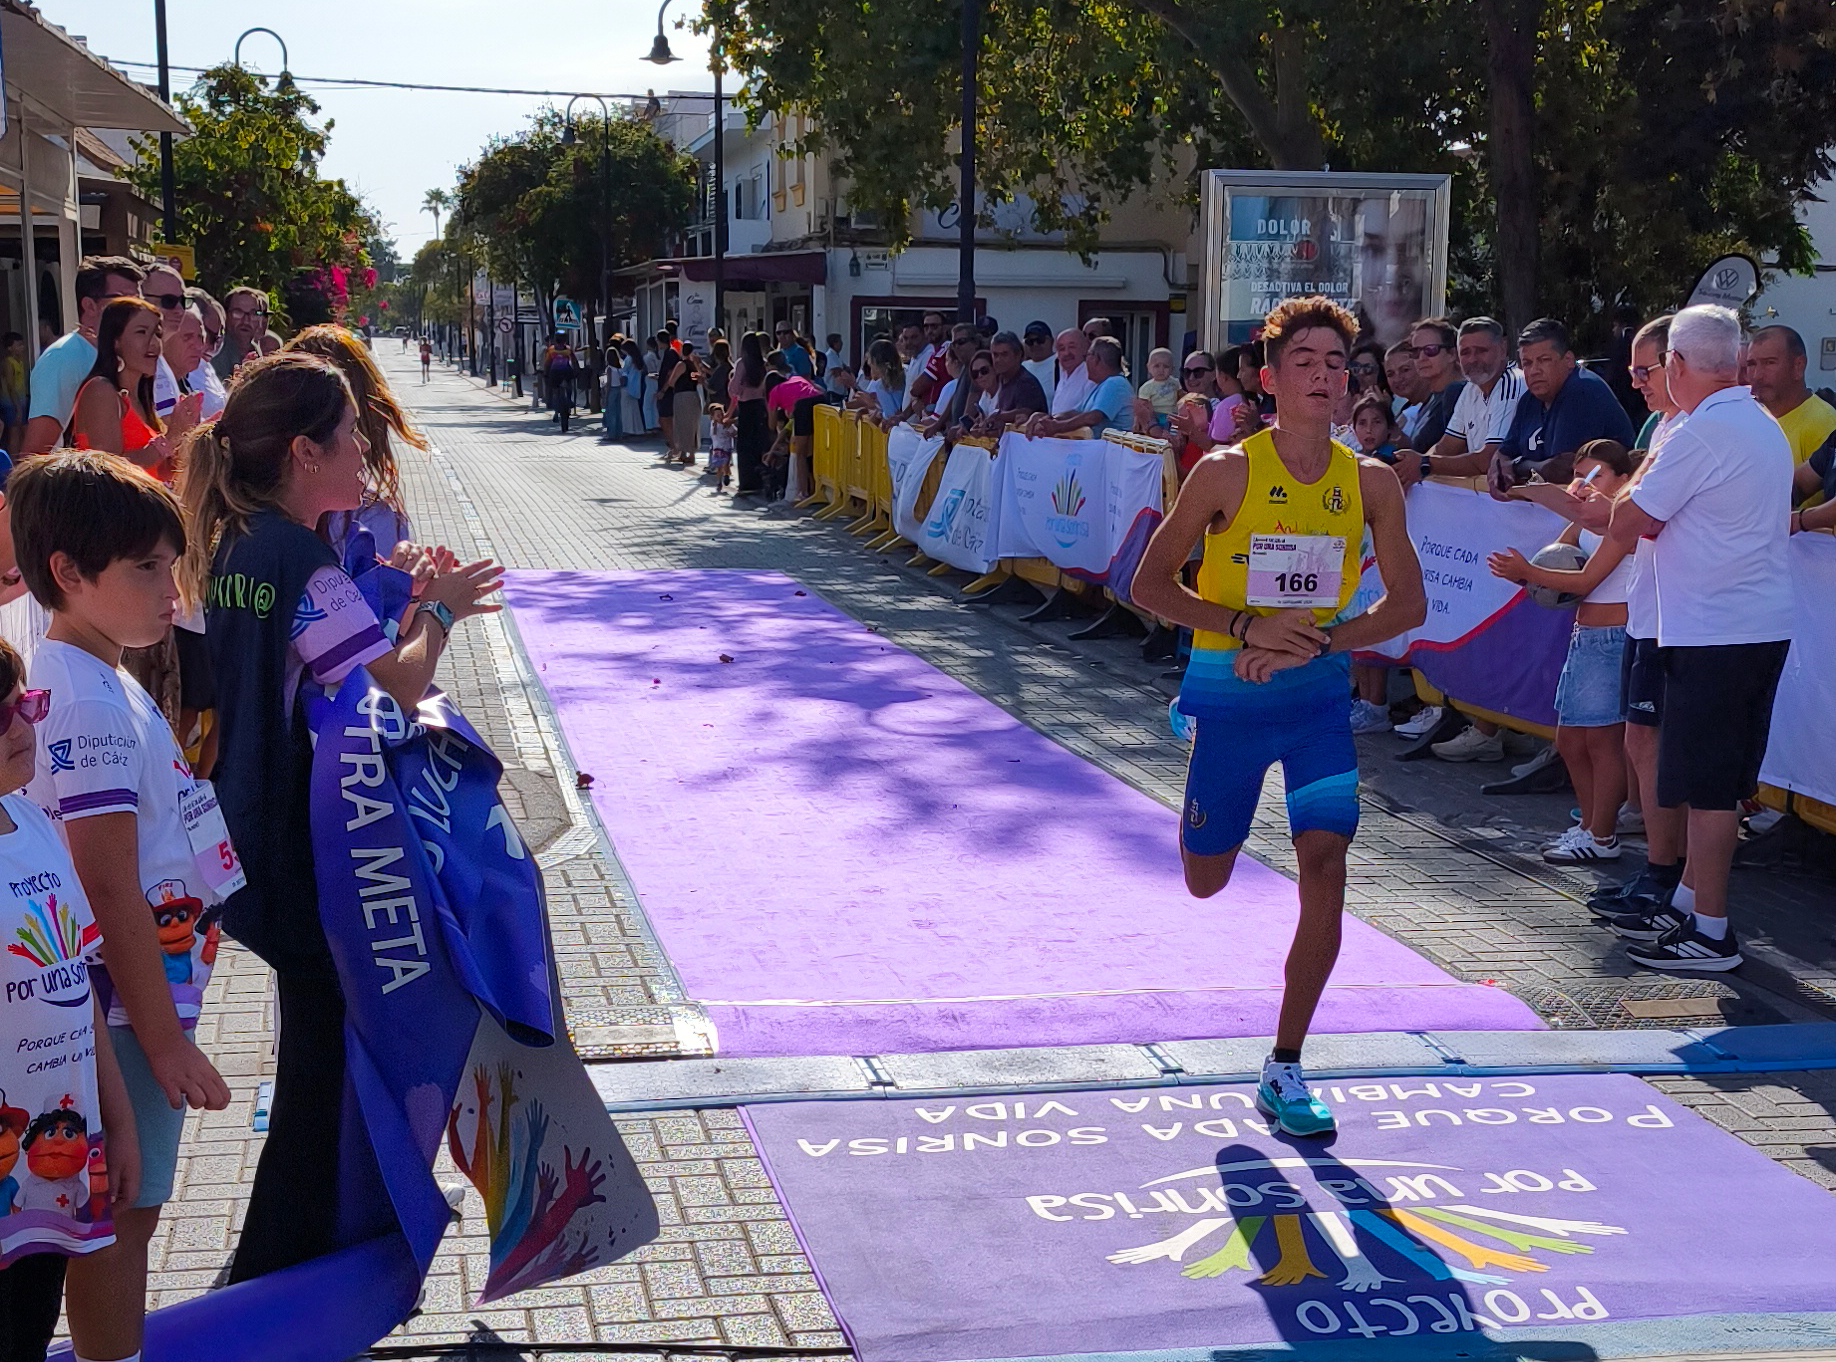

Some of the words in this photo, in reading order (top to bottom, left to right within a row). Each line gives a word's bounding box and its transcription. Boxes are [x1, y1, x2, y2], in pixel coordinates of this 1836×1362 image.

[1257, 218, 1312, 236] DOLOR
[1251, 281, 1303, 292] DESACTIVA
[1304, 282, 1316, 293] EL
[1318, 282, 1349, 293] DOLOR
[1421, 535, 1453, 559] PORQUE
[1453, 548, 1479, 566] CADA
[1275, 573, 1318, 592] 166
[1441, 573, 1473, 592] CAMBIA
[330, 597, 347, 611] de
[80, 754, 98, 768] de
[351, 846, 432, 995] META
[17, 1032, 67, 1053] PORQUE
[26, 1056, 68, 1075] CAMBIA
[1109, 1092, 1255, 1113] UNA
[1312, 1082, 1537, 1103] CAMBI
[914, 1100, 1079, 1124] VIDA
[1370, 1104, 1676, 1131] PORQUE
[1140, 1117, 1338, 1141] ADA
[797, 1126, 1109, 1157] SONRISA
